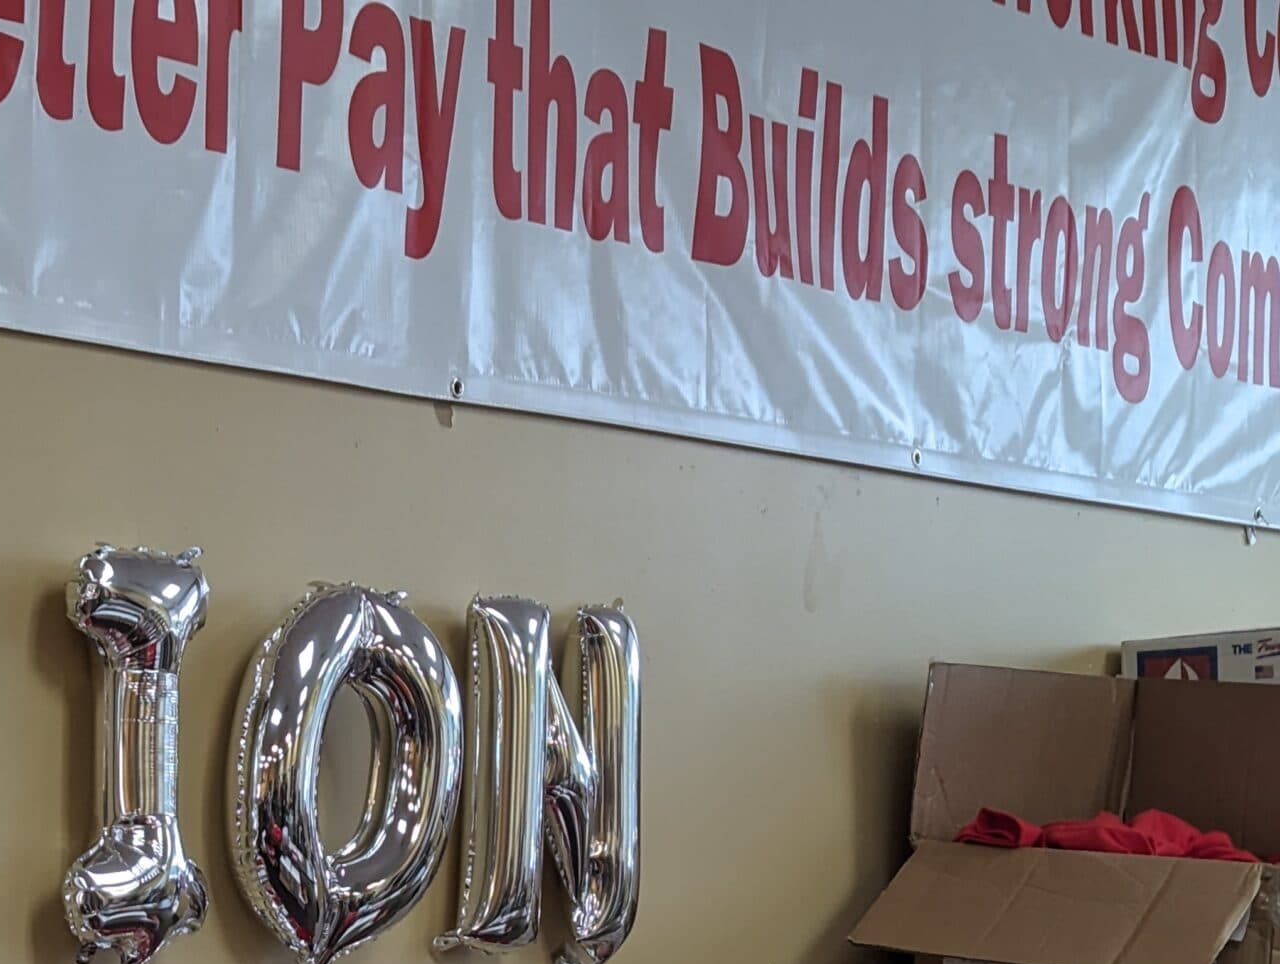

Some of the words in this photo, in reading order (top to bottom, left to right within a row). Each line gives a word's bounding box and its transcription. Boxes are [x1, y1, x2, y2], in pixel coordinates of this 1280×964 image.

[276, 0, 466, 260] Pay
[487, 0, 674, 253] that
[690, 43, 929, 312] Builds
[948, 133, 1152, 404] strong
